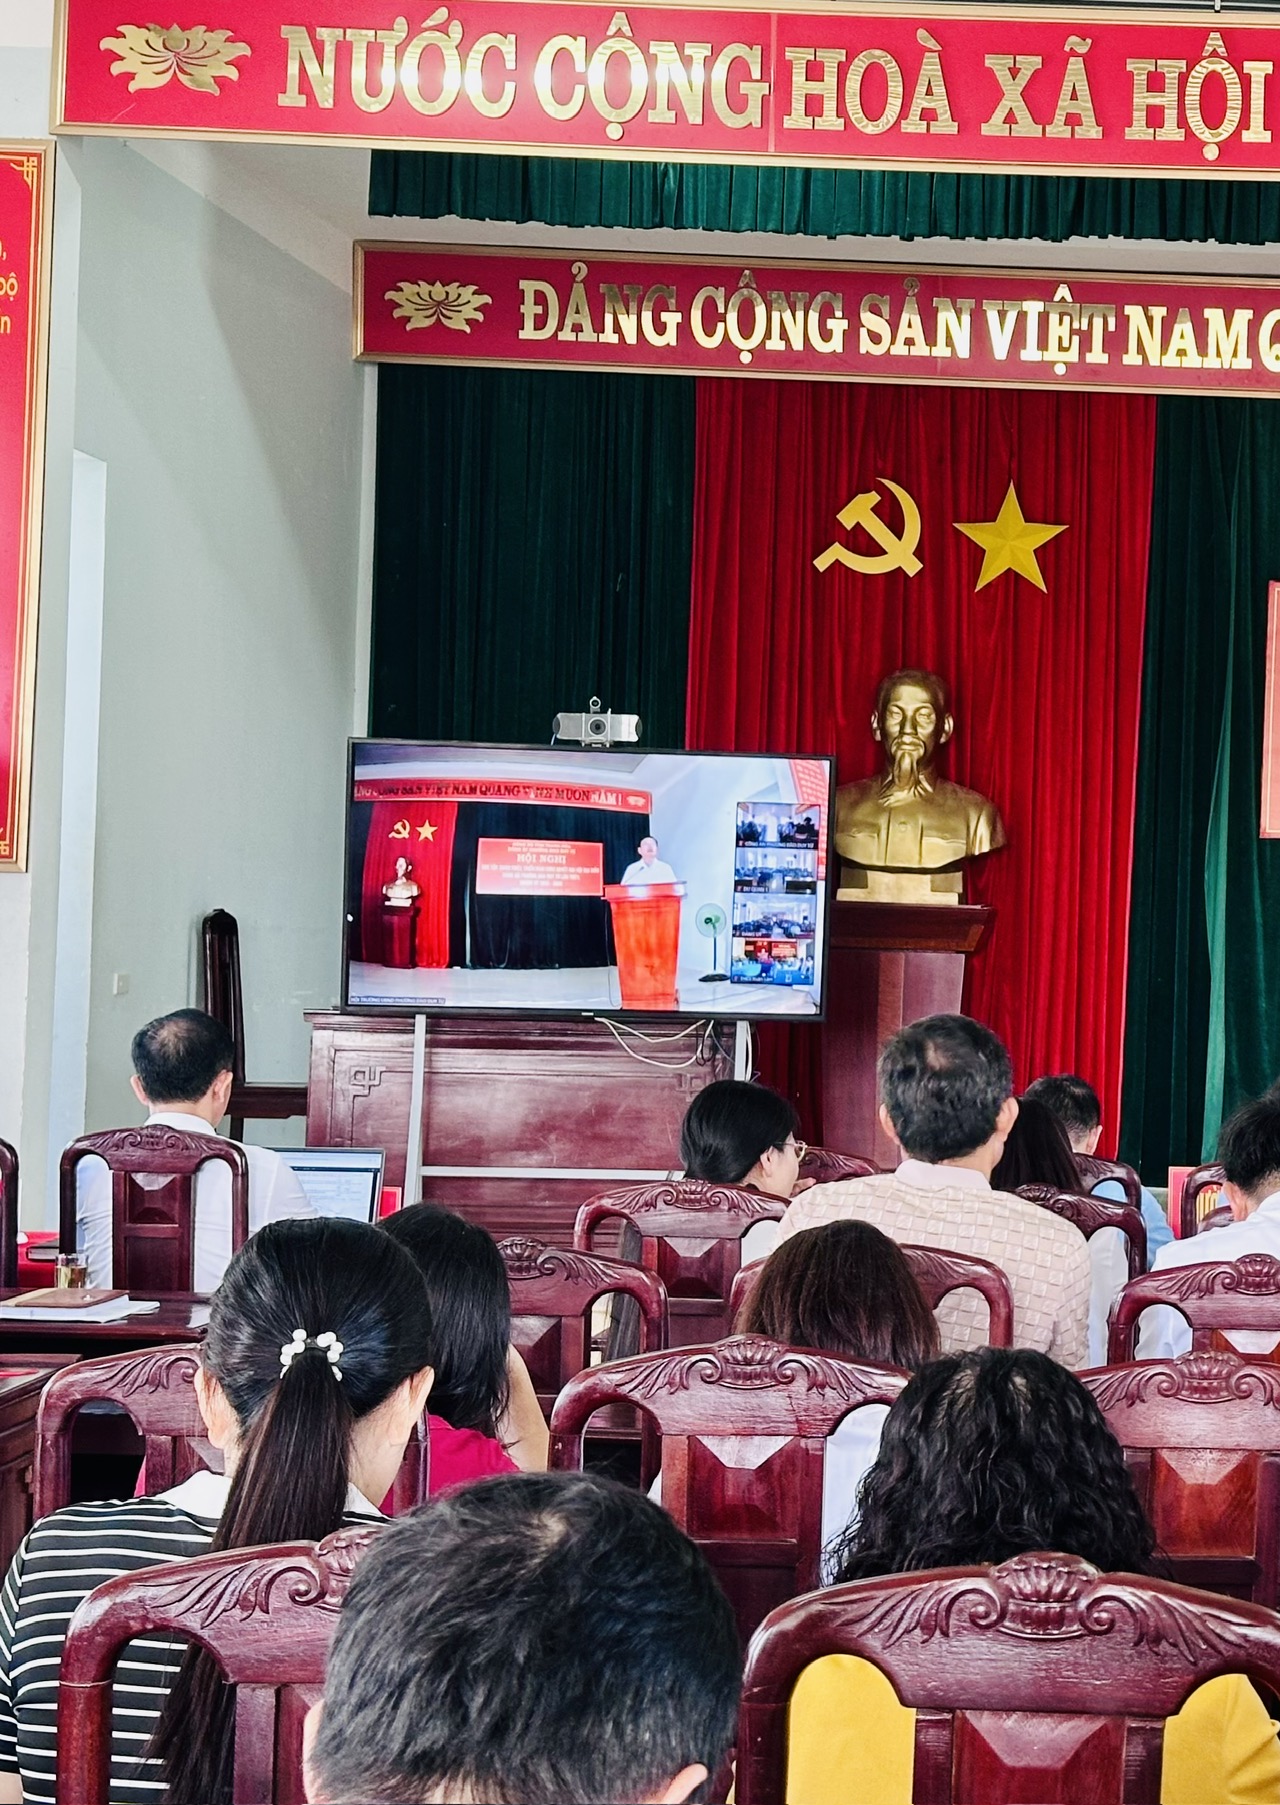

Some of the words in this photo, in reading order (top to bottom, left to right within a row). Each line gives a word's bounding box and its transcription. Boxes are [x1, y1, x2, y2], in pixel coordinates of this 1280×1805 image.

[276, 7, 517, 119] NƯỚC
[534, 10, 772, 141] CỘNG
[782, 28, 958, 136] HOÀ
[980, 35, 1103, 139] XÃ
[1125, 31, 1273, 162] HỘI
[517, 261, 684, 345] ĐẢNG
[692, 268, 849, 365] CỘNG
[858, 277, 975, 360] SẢN
[983, 282, 1117, 377] VIỆT
[1123, 303, 1253, 371] NAM
